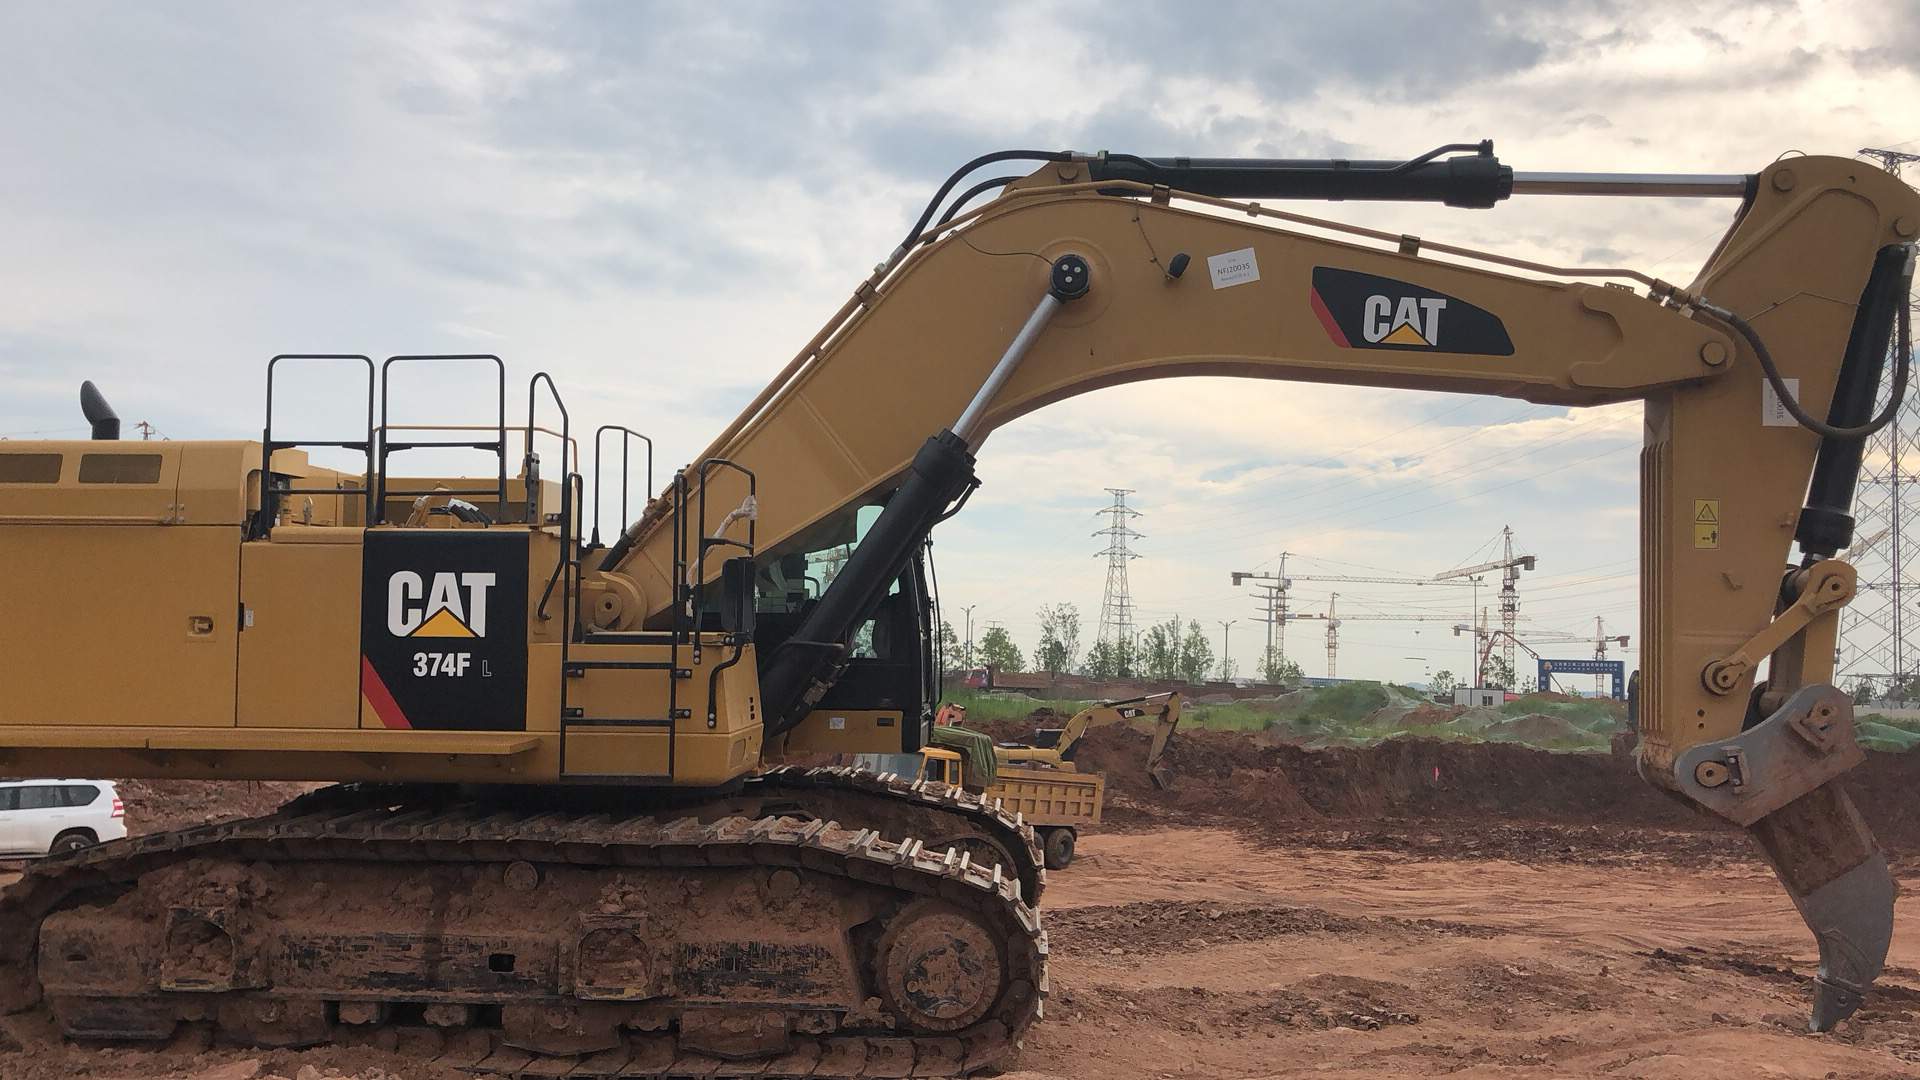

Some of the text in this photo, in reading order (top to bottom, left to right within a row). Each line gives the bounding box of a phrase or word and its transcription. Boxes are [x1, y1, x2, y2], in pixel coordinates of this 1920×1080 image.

[1363, 295, 1447, 346] CAT
[387, 570, 496, 638] CAT
[413, 652, 492, 677] 374F L
[1124, 709, 1136, 718] CAT
